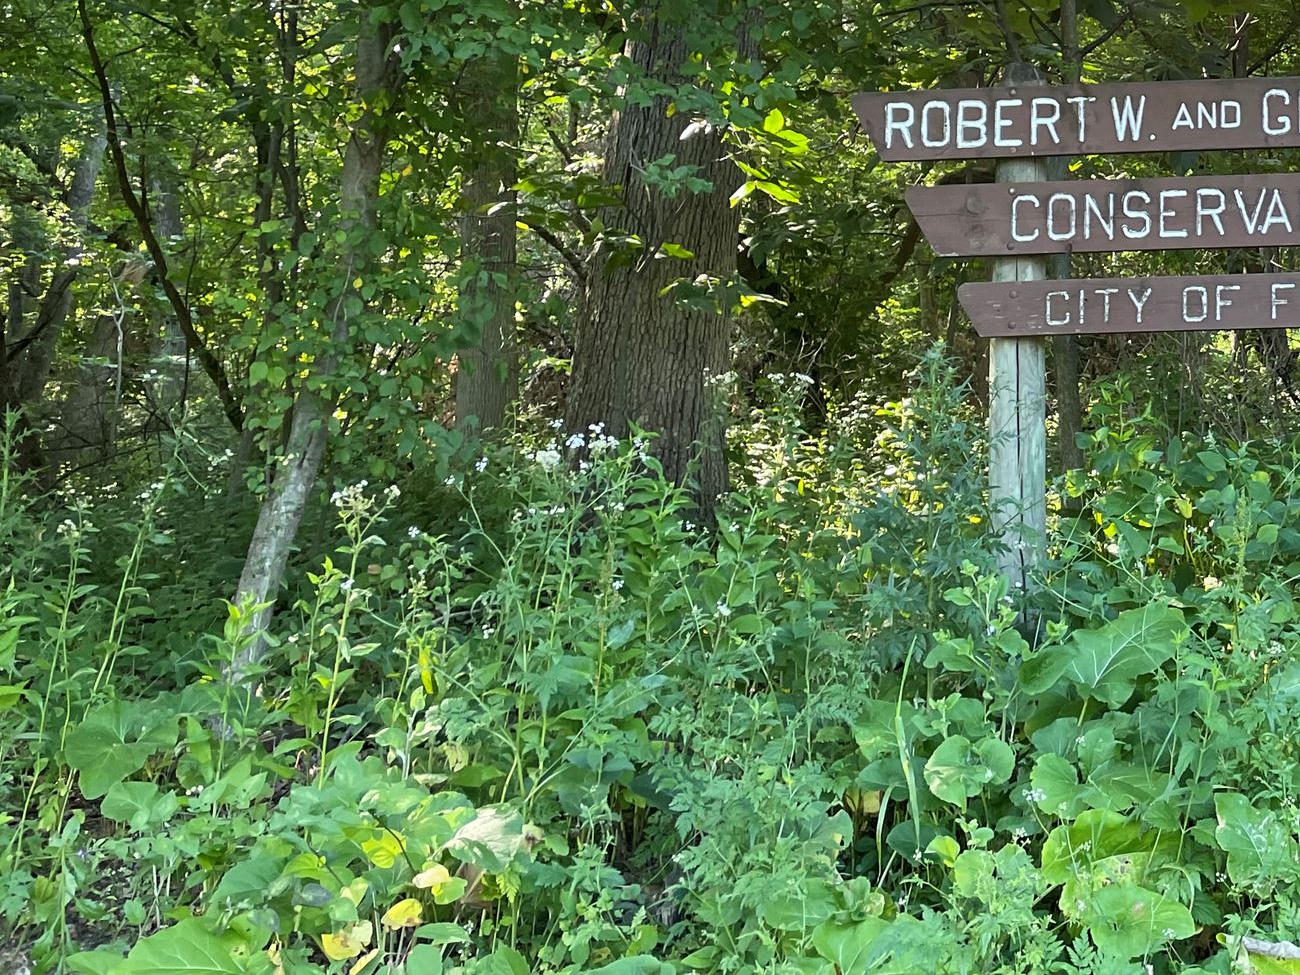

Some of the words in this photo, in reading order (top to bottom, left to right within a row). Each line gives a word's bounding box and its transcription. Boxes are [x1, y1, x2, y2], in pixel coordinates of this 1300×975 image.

[884, 96, 1096, 149] ROBERT
[1110, 94, 1156, 143] W.
[1171, 100, 1242, 131] AND
[1045, 287, 1152, 327] CITY
[1182, 284, 1241, 323] OF
